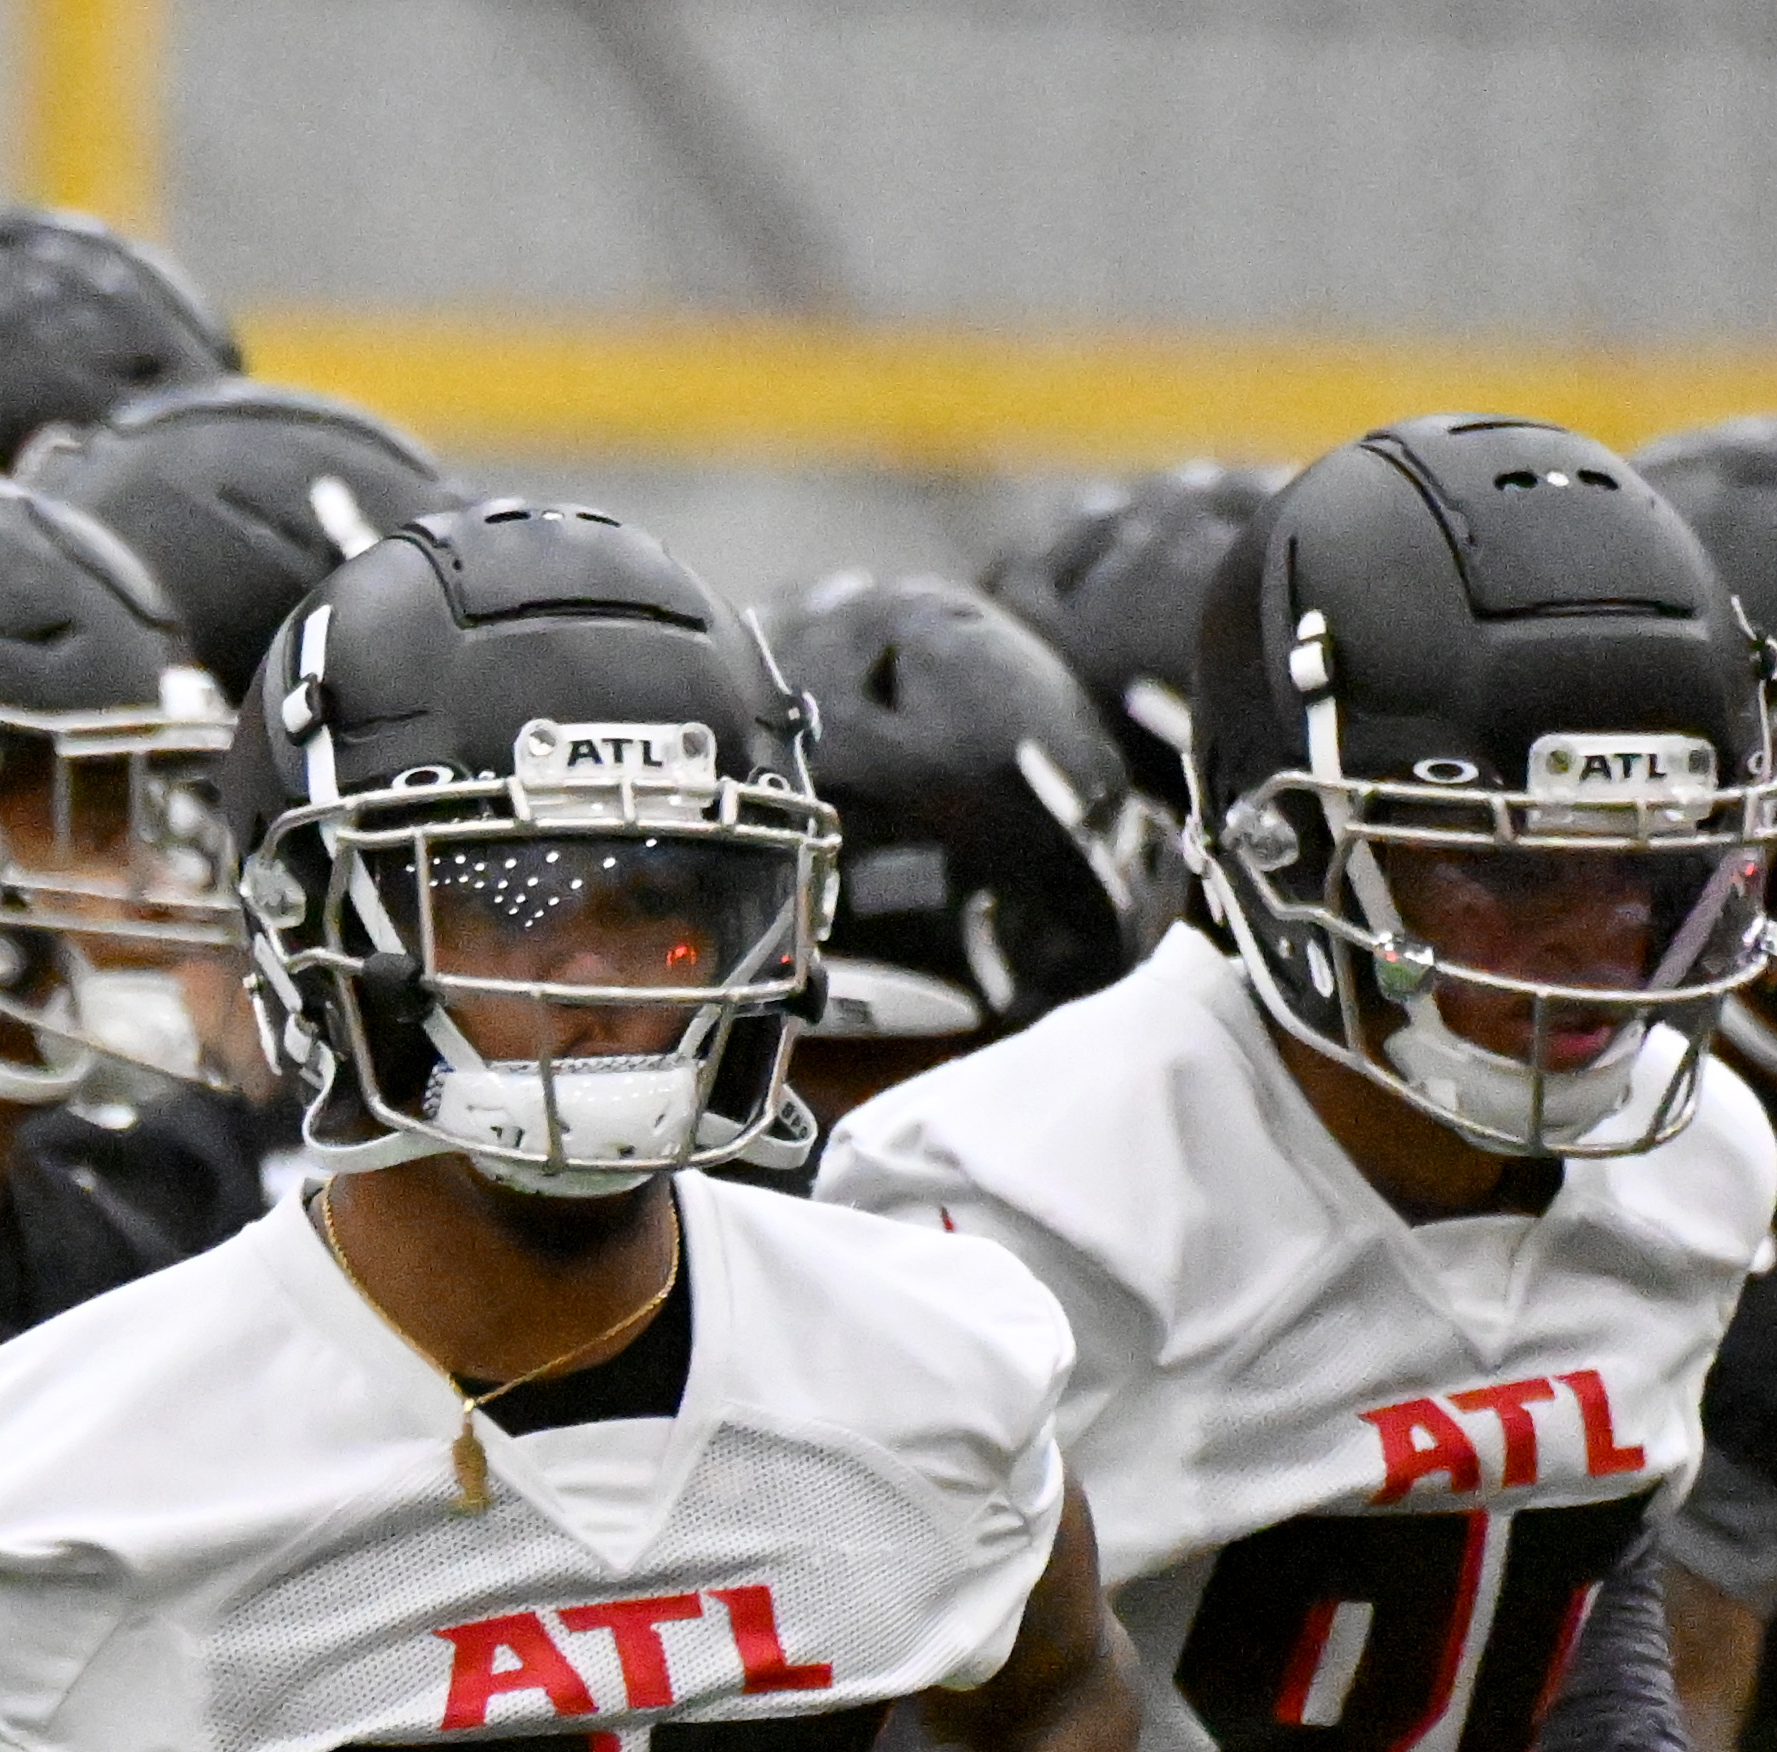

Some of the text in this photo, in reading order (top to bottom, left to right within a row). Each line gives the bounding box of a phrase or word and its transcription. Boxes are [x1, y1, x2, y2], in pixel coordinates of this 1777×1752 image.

[567, 738, 663, 767] ATL
[1579, 753, 1667, 781] ATL
[1358, 1369, 1646, 1505] ATL
[433, 1584, 833, 1732] ATL
